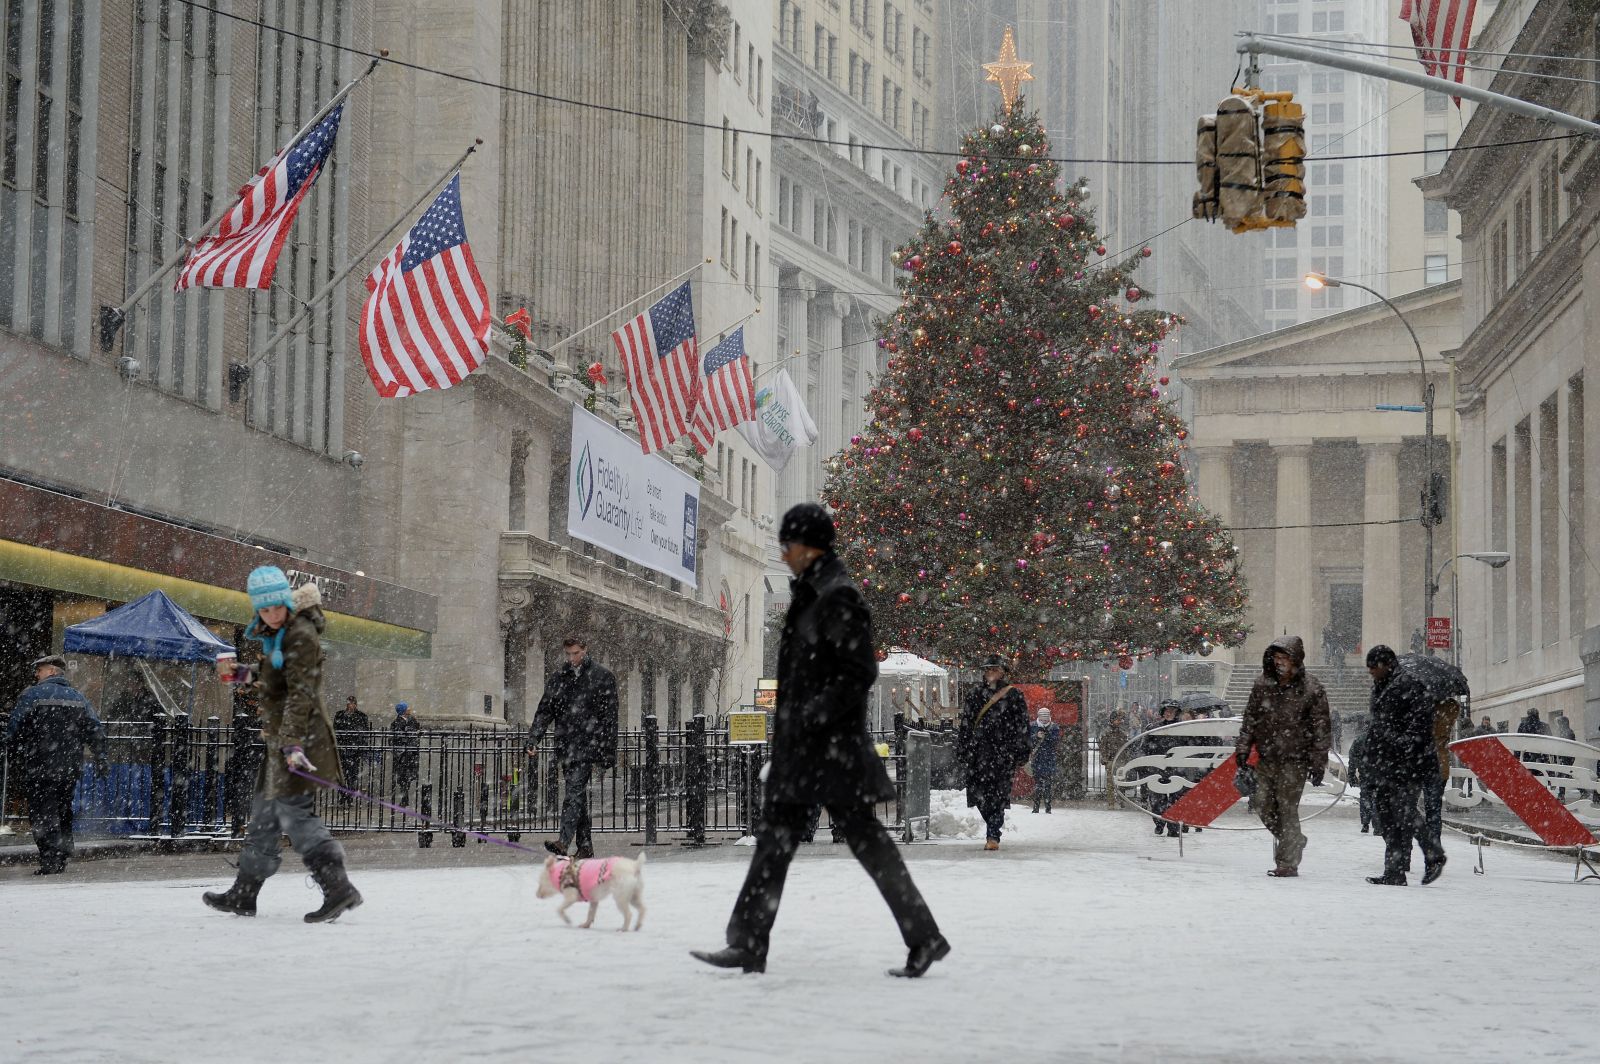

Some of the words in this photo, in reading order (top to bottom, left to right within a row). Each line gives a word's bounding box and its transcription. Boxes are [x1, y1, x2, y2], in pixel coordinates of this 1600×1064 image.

[761, 410, 795, 448] EURONEXT
[770, 401, 791, 422] NYSE
[597, 457, 623, 503] Fidelity
[624, 472, 630, 500] &
[595, 490, 631, 540] Guaranty
